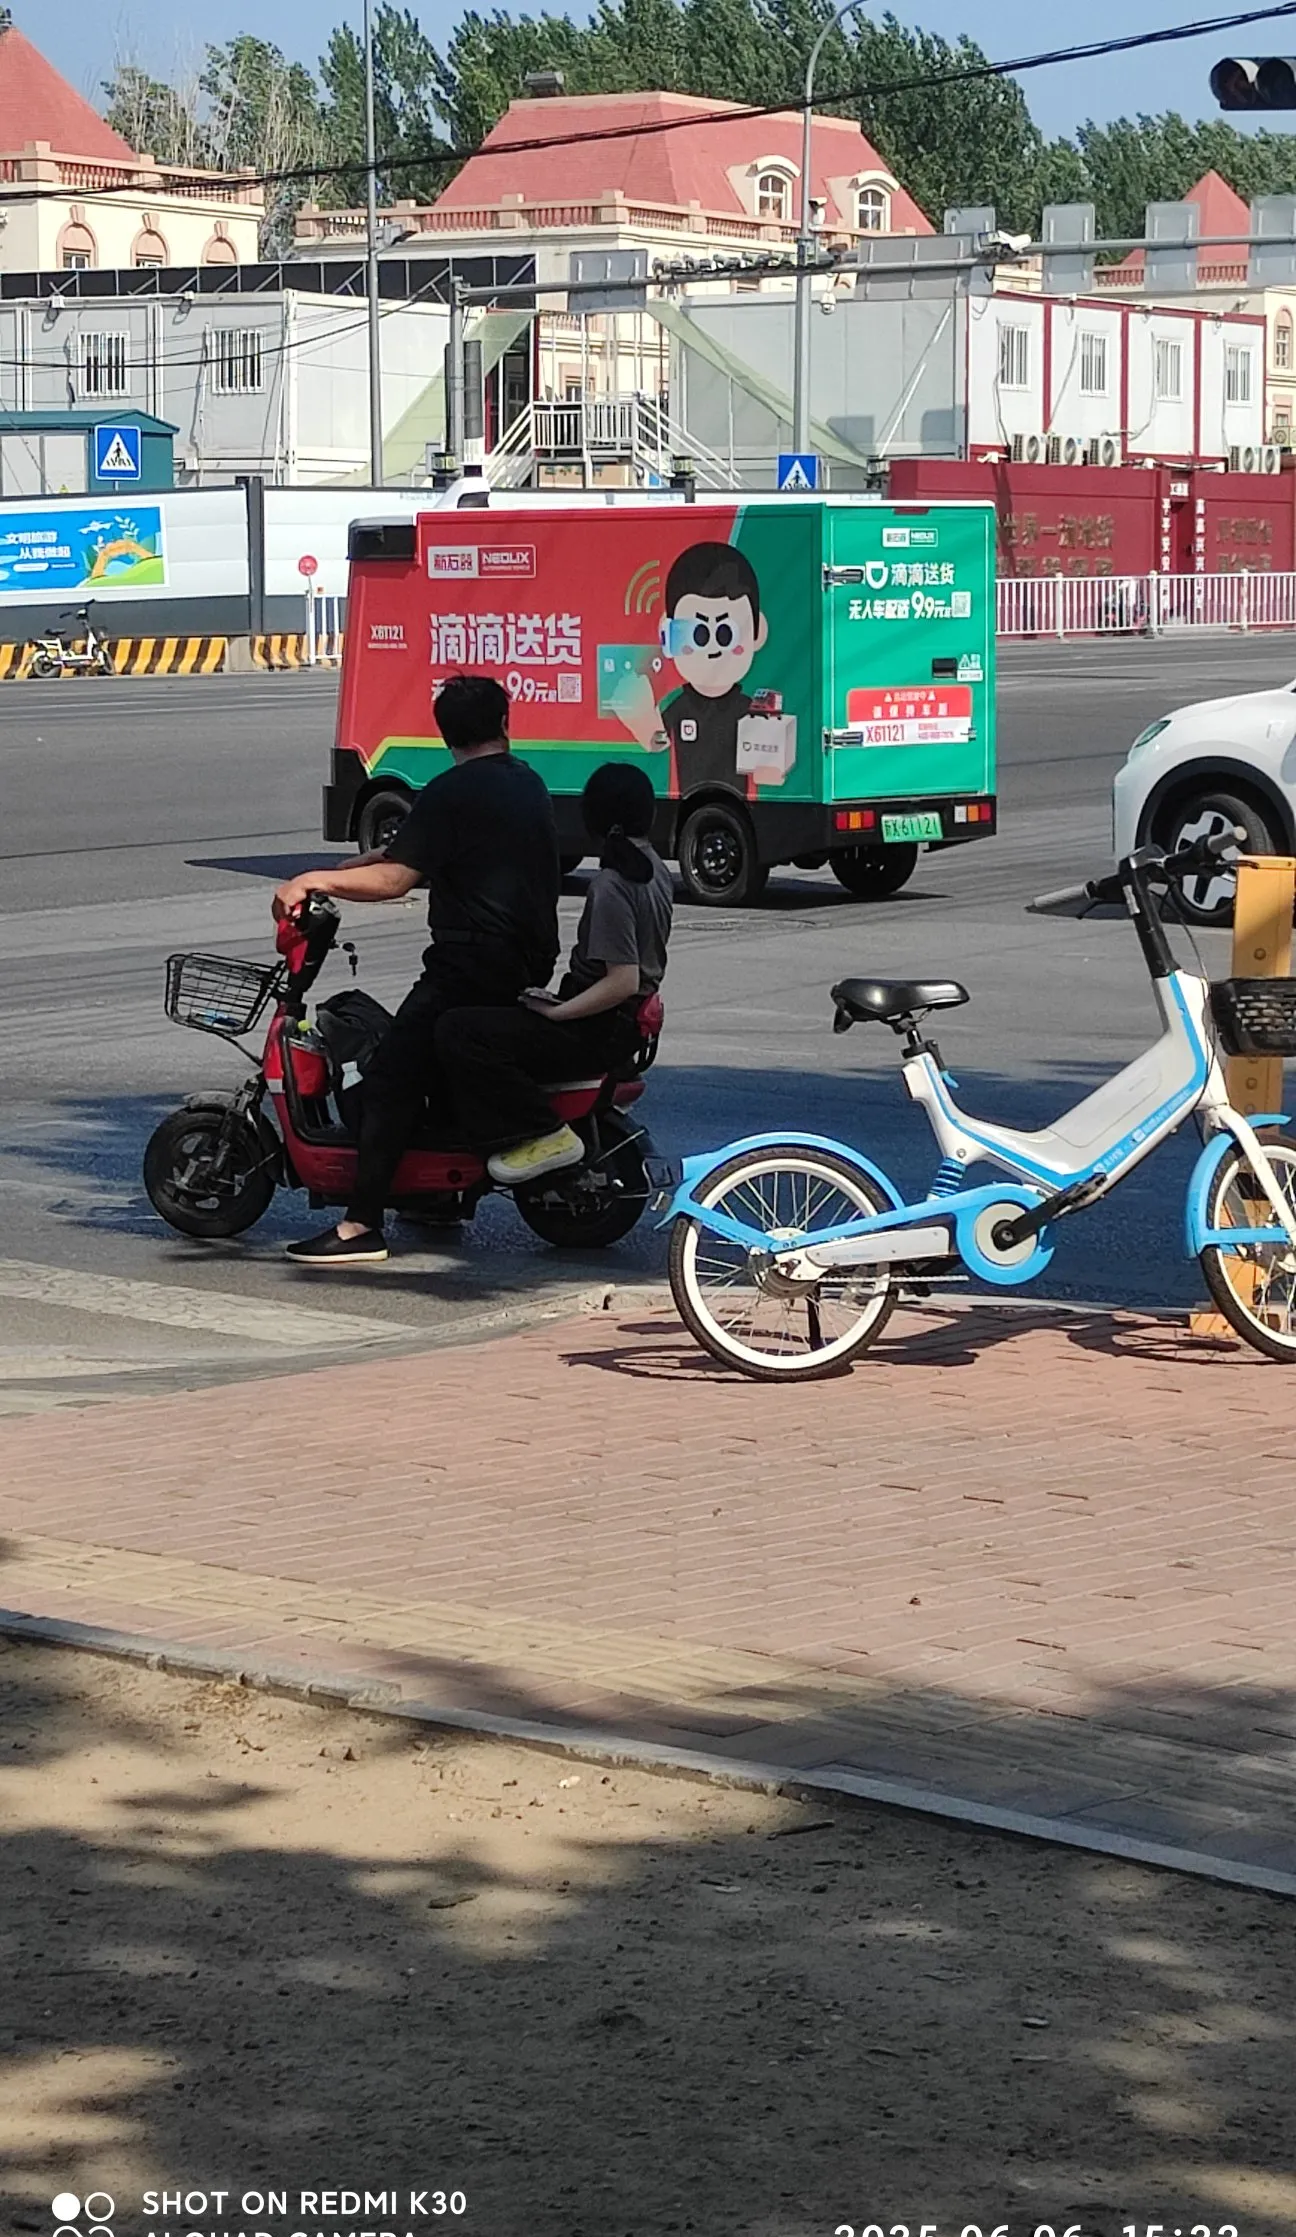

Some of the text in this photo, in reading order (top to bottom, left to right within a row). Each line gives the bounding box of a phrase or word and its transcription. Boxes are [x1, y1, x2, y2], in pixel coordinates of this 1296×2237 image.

[482, 552, 529, 564] NEOLIX
[891, 562, 955, 587] 滴滴送货
[430, 613, 582, 665] 滴滴送货
[866, 724, 905, 743] X61121
